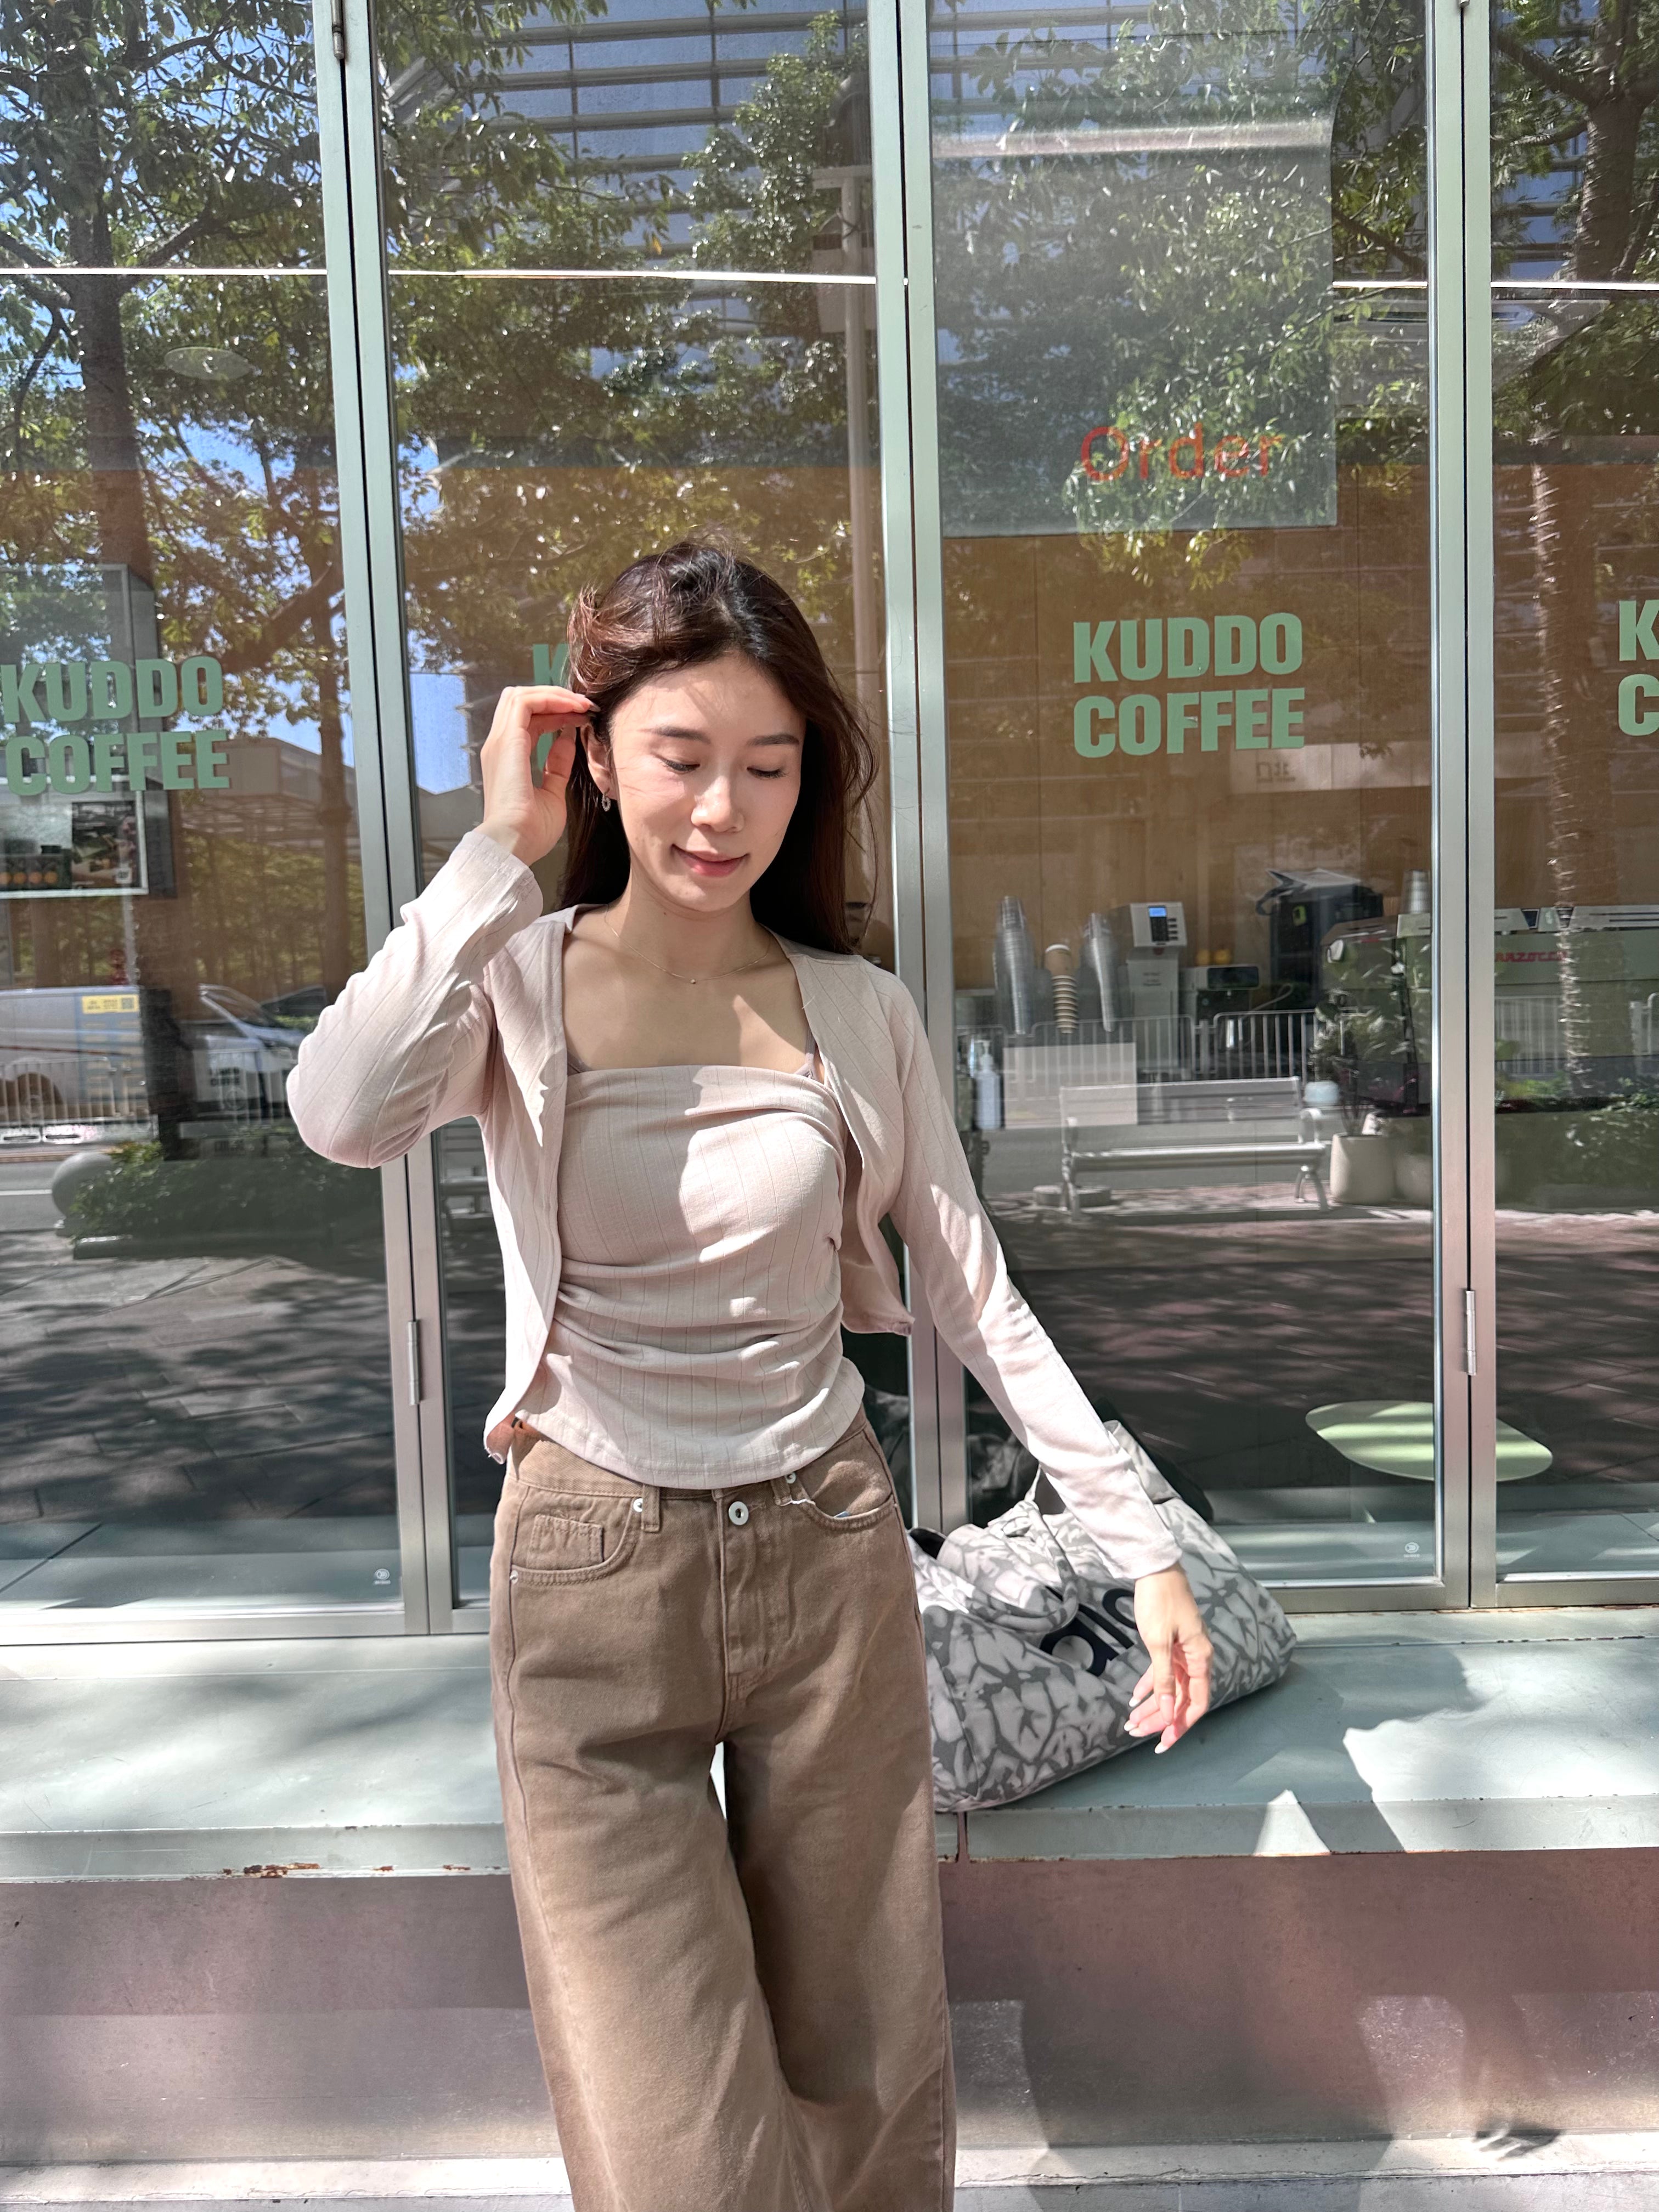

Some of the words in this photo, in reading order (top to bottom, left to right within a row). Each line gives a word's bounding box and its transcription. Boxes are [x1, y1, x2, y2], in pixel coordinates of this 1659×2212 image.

[1081, 422, 1283, 481] Order
[1073, 613, 1302, 684] KUDDO
[0, 656, 223, 723] KUDDO
[1073, 688, 1305, 758] COFFEE
[5, 730, 230, 795] COFFEE
